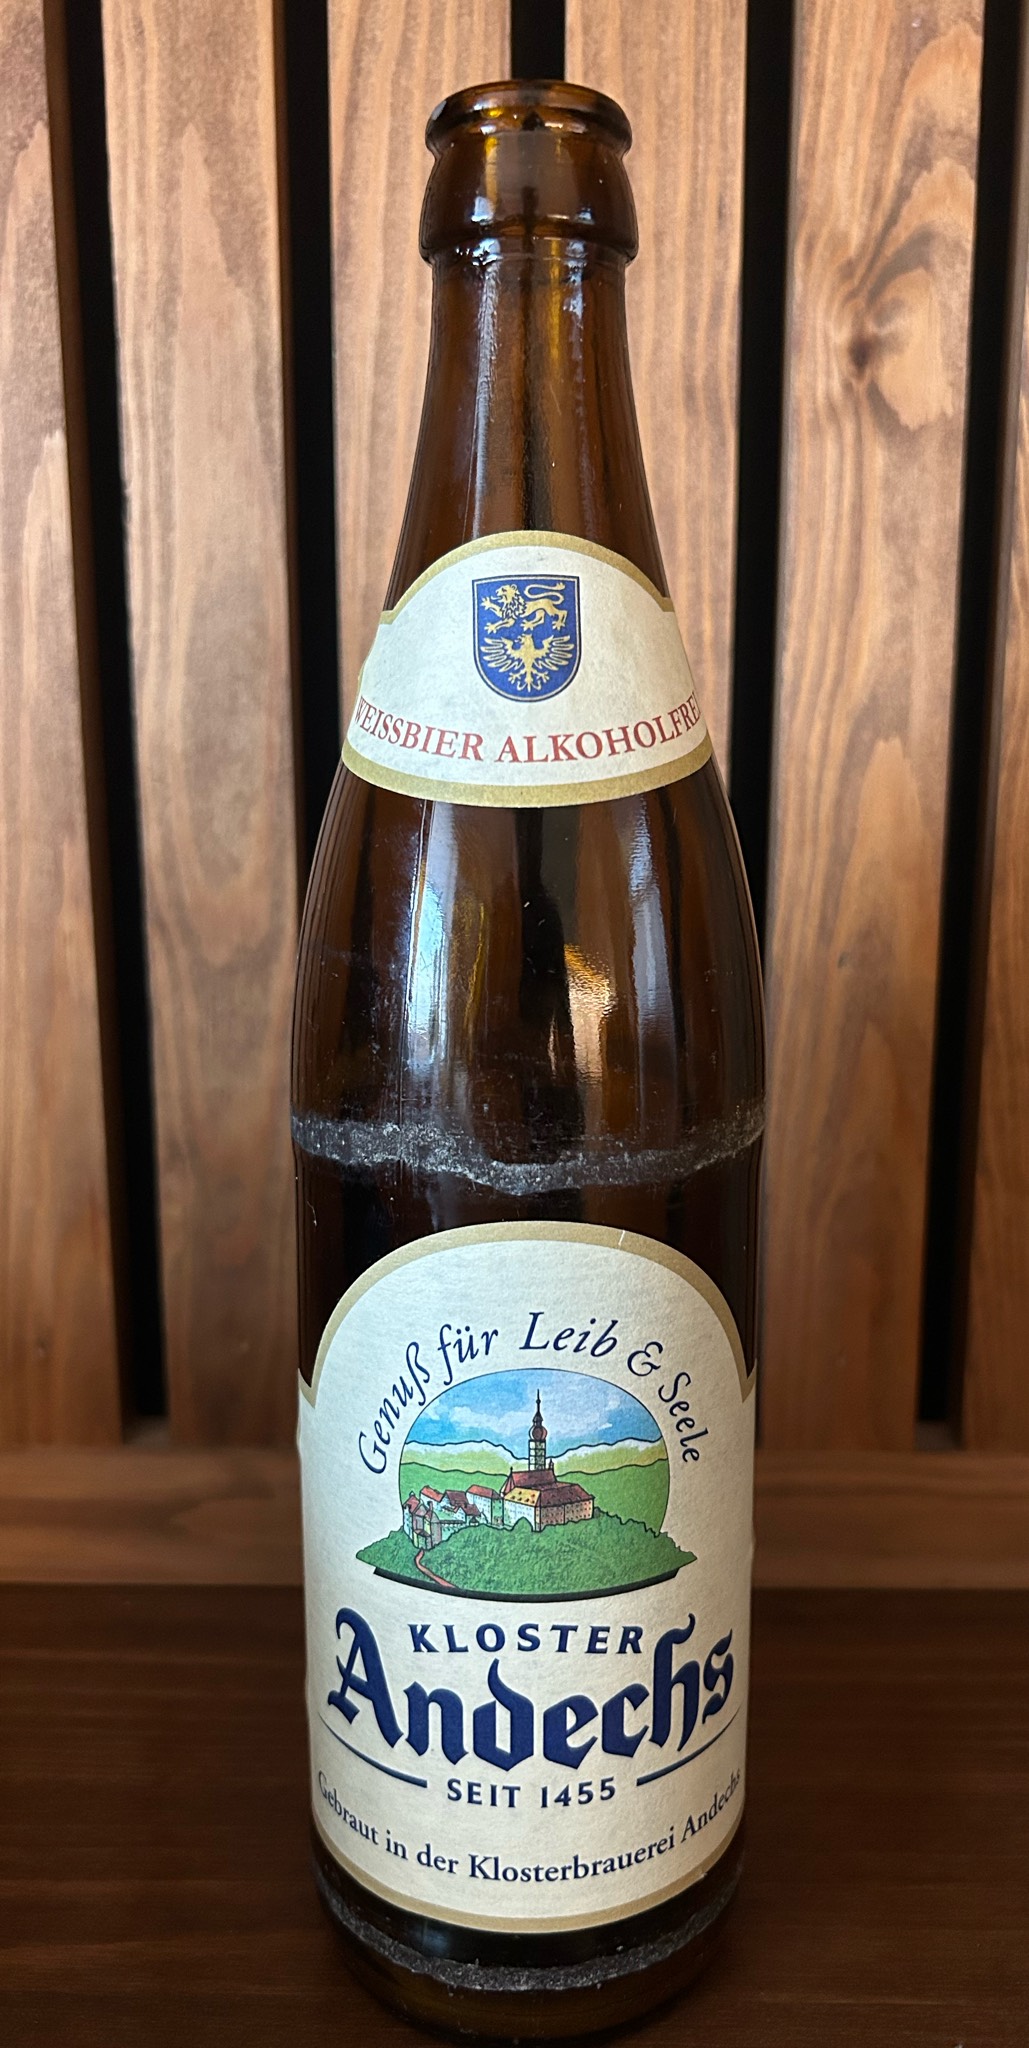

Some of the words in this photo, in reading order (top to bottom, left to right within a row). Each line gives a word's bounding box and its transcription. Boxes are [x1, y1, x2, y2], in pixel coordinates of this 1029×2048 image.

[355, 695, 484, 762] WEISSBIER
[494, 691, 701, 763] ALKOHOLFRE
[358, 1341, 431, 1475] Genuß
[437, 1323, 499, 1386] für
[519, 1311, 619, 1357] Leib
[626, 1341, 664, 1377] &
[658, 1372, 709, 1463] Seele
[408, 1623, 645, 1654] KLOSTER
[327, 1606, 734, 1772] Andechs
[318, 1769, 379, 1846] Gebraut
[386, 1829, 409, 1861] in
[416, 1843, 459, 1875] der
[468, 1825, 675, 1883] Klosterbrauerei
[681, 1767, 741, 1844] Andechs
[446, 1778, 521, 1808] SEIT
[540, 1776, 616, 1808] 1455
